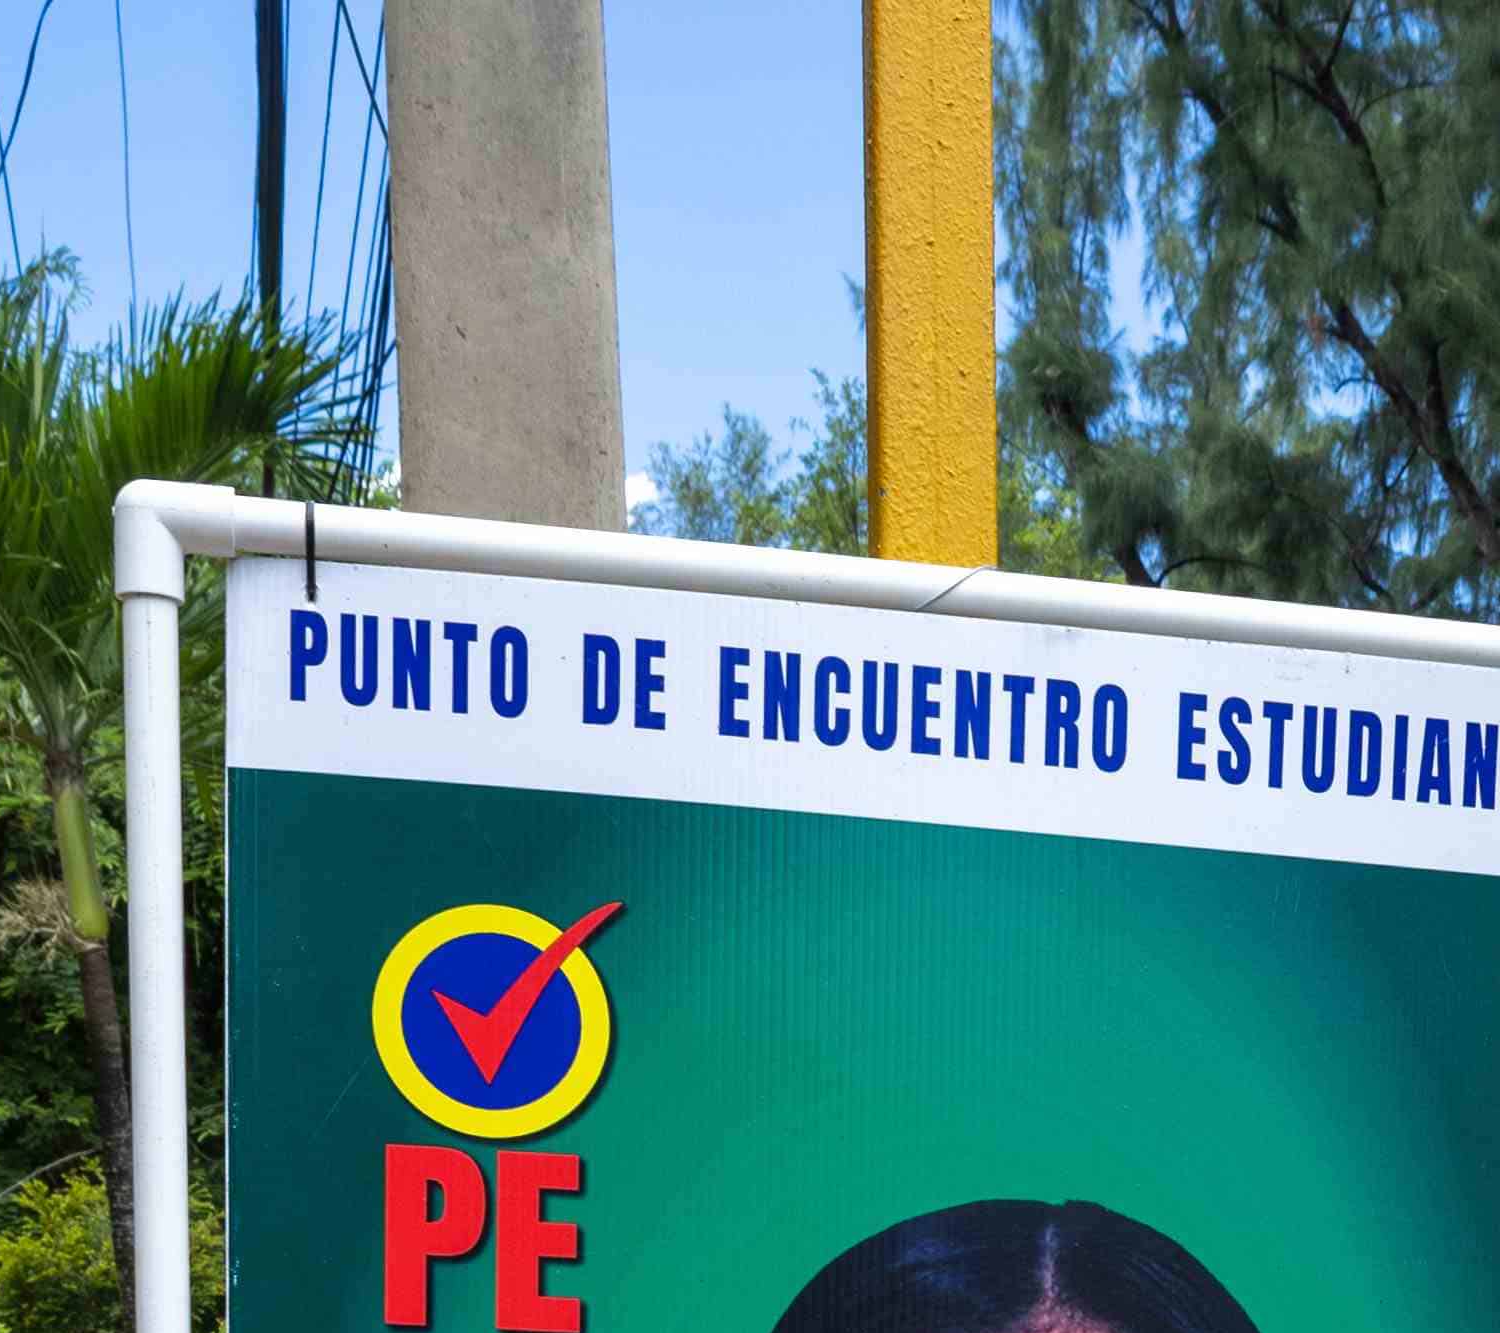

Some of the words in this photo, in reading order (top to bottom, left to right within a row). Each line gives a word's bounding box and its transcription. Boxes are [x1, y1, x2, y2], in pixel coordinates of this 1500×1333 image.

[290, 609, 529, 719] PUNTO
[582, 633, 666, 731] DE
[718, 646, 1128, 773] ENCUENTRO
[383, 1143, 581, 1333] PE
